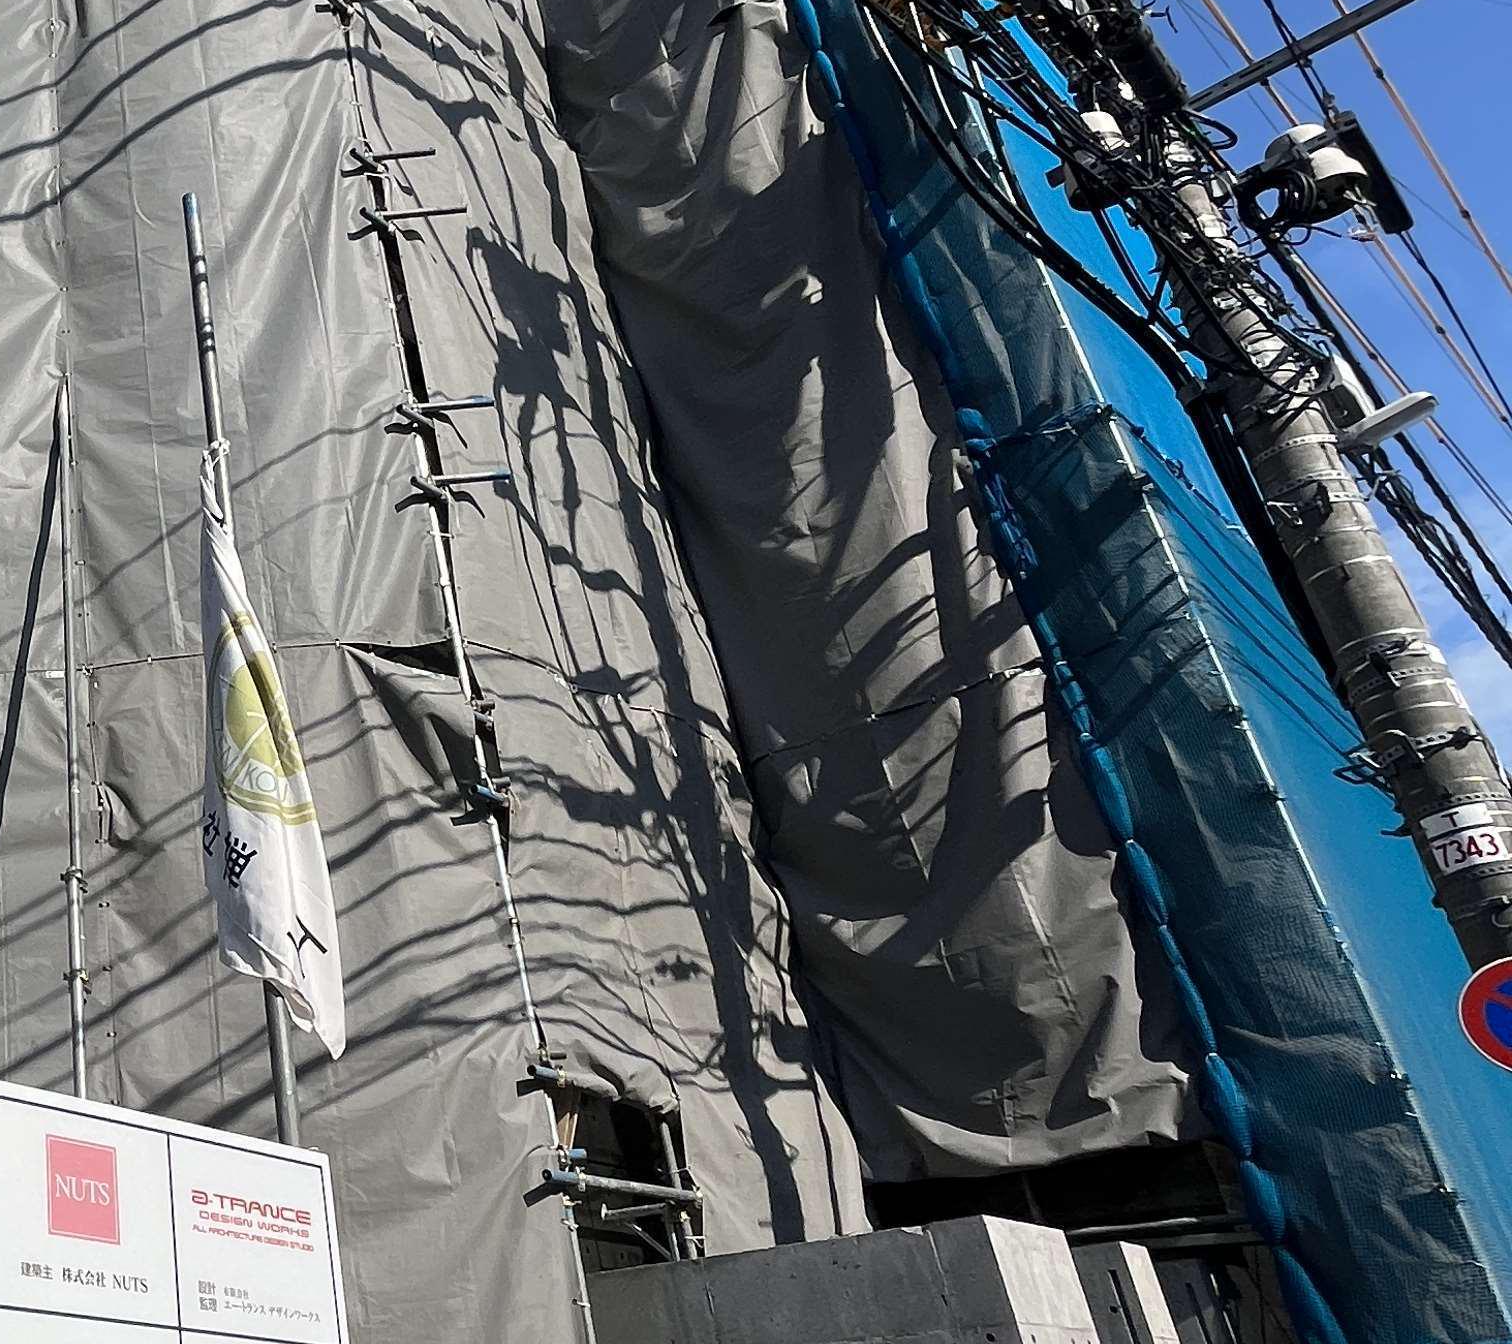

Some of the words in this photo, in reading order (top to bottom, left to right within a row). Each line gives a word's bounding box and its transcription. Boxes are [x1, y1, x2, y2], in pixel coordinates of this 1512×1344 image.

[1440, 810, 1460, 828] T
[1434, 833, 1500, 868] 7343
[55, 1172, 111, 1206] NUTS
[199, 1210, 253, 1228] DESIGN
[256, 1220, 310, 1238] WORKS
[20, 1261, 54, 1280] 建築主
[62, 1266, 107, 1288] 株式会社
[112, 1273, 149, 1294] NUTS
[198, 1279, 216, 1295] 設計
[199, 1296, 217, 1312] 監理
